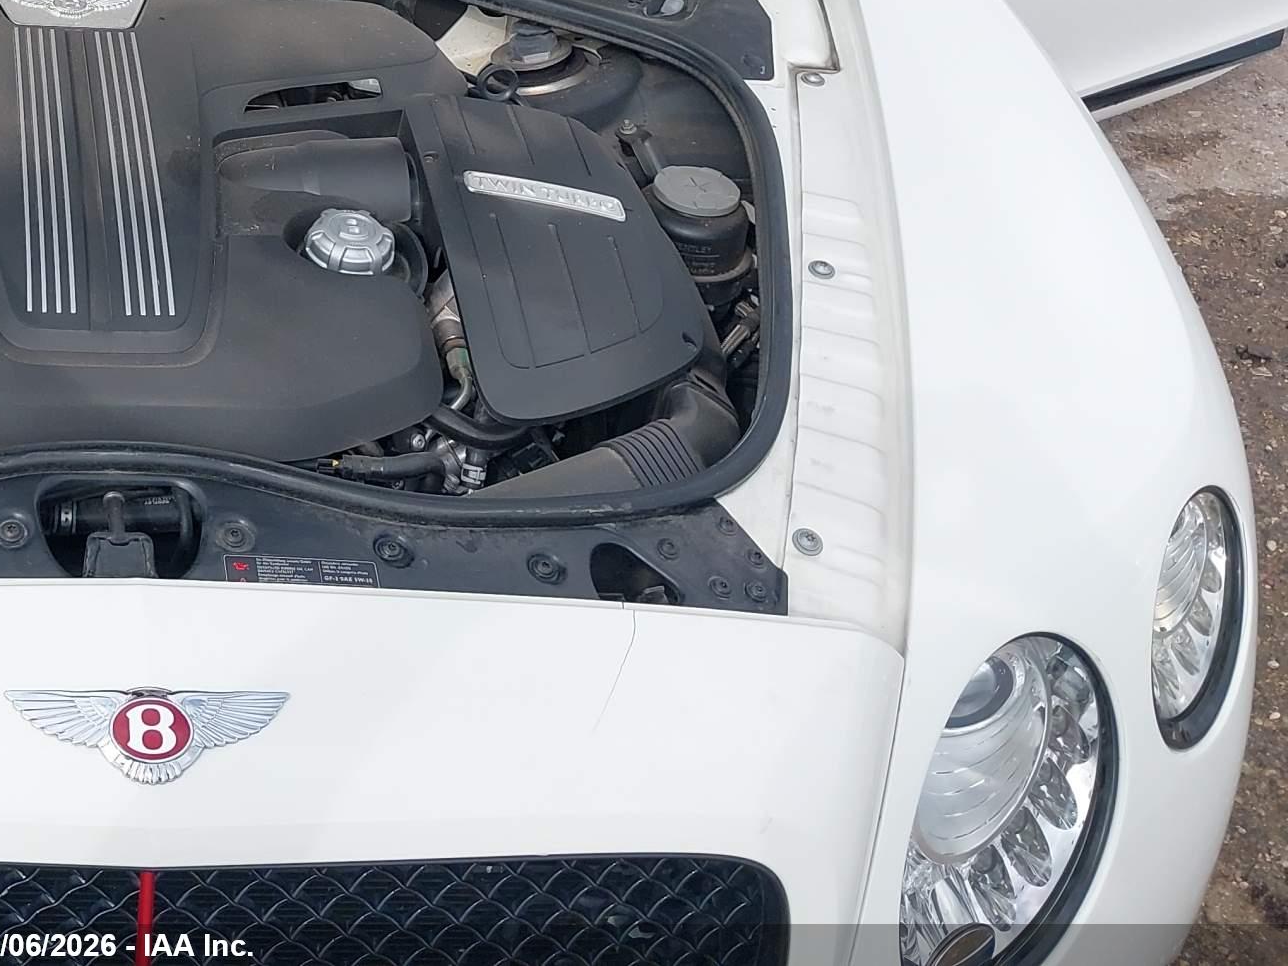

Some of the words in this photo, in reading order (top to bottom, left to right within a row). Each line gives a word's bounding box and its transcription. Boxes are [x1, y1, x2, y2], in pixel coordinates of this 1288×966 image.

[476, 176, 537, 196] TWIN
[542, 187, 616, 212] TURBO
[126, 704, 177, 755] B
